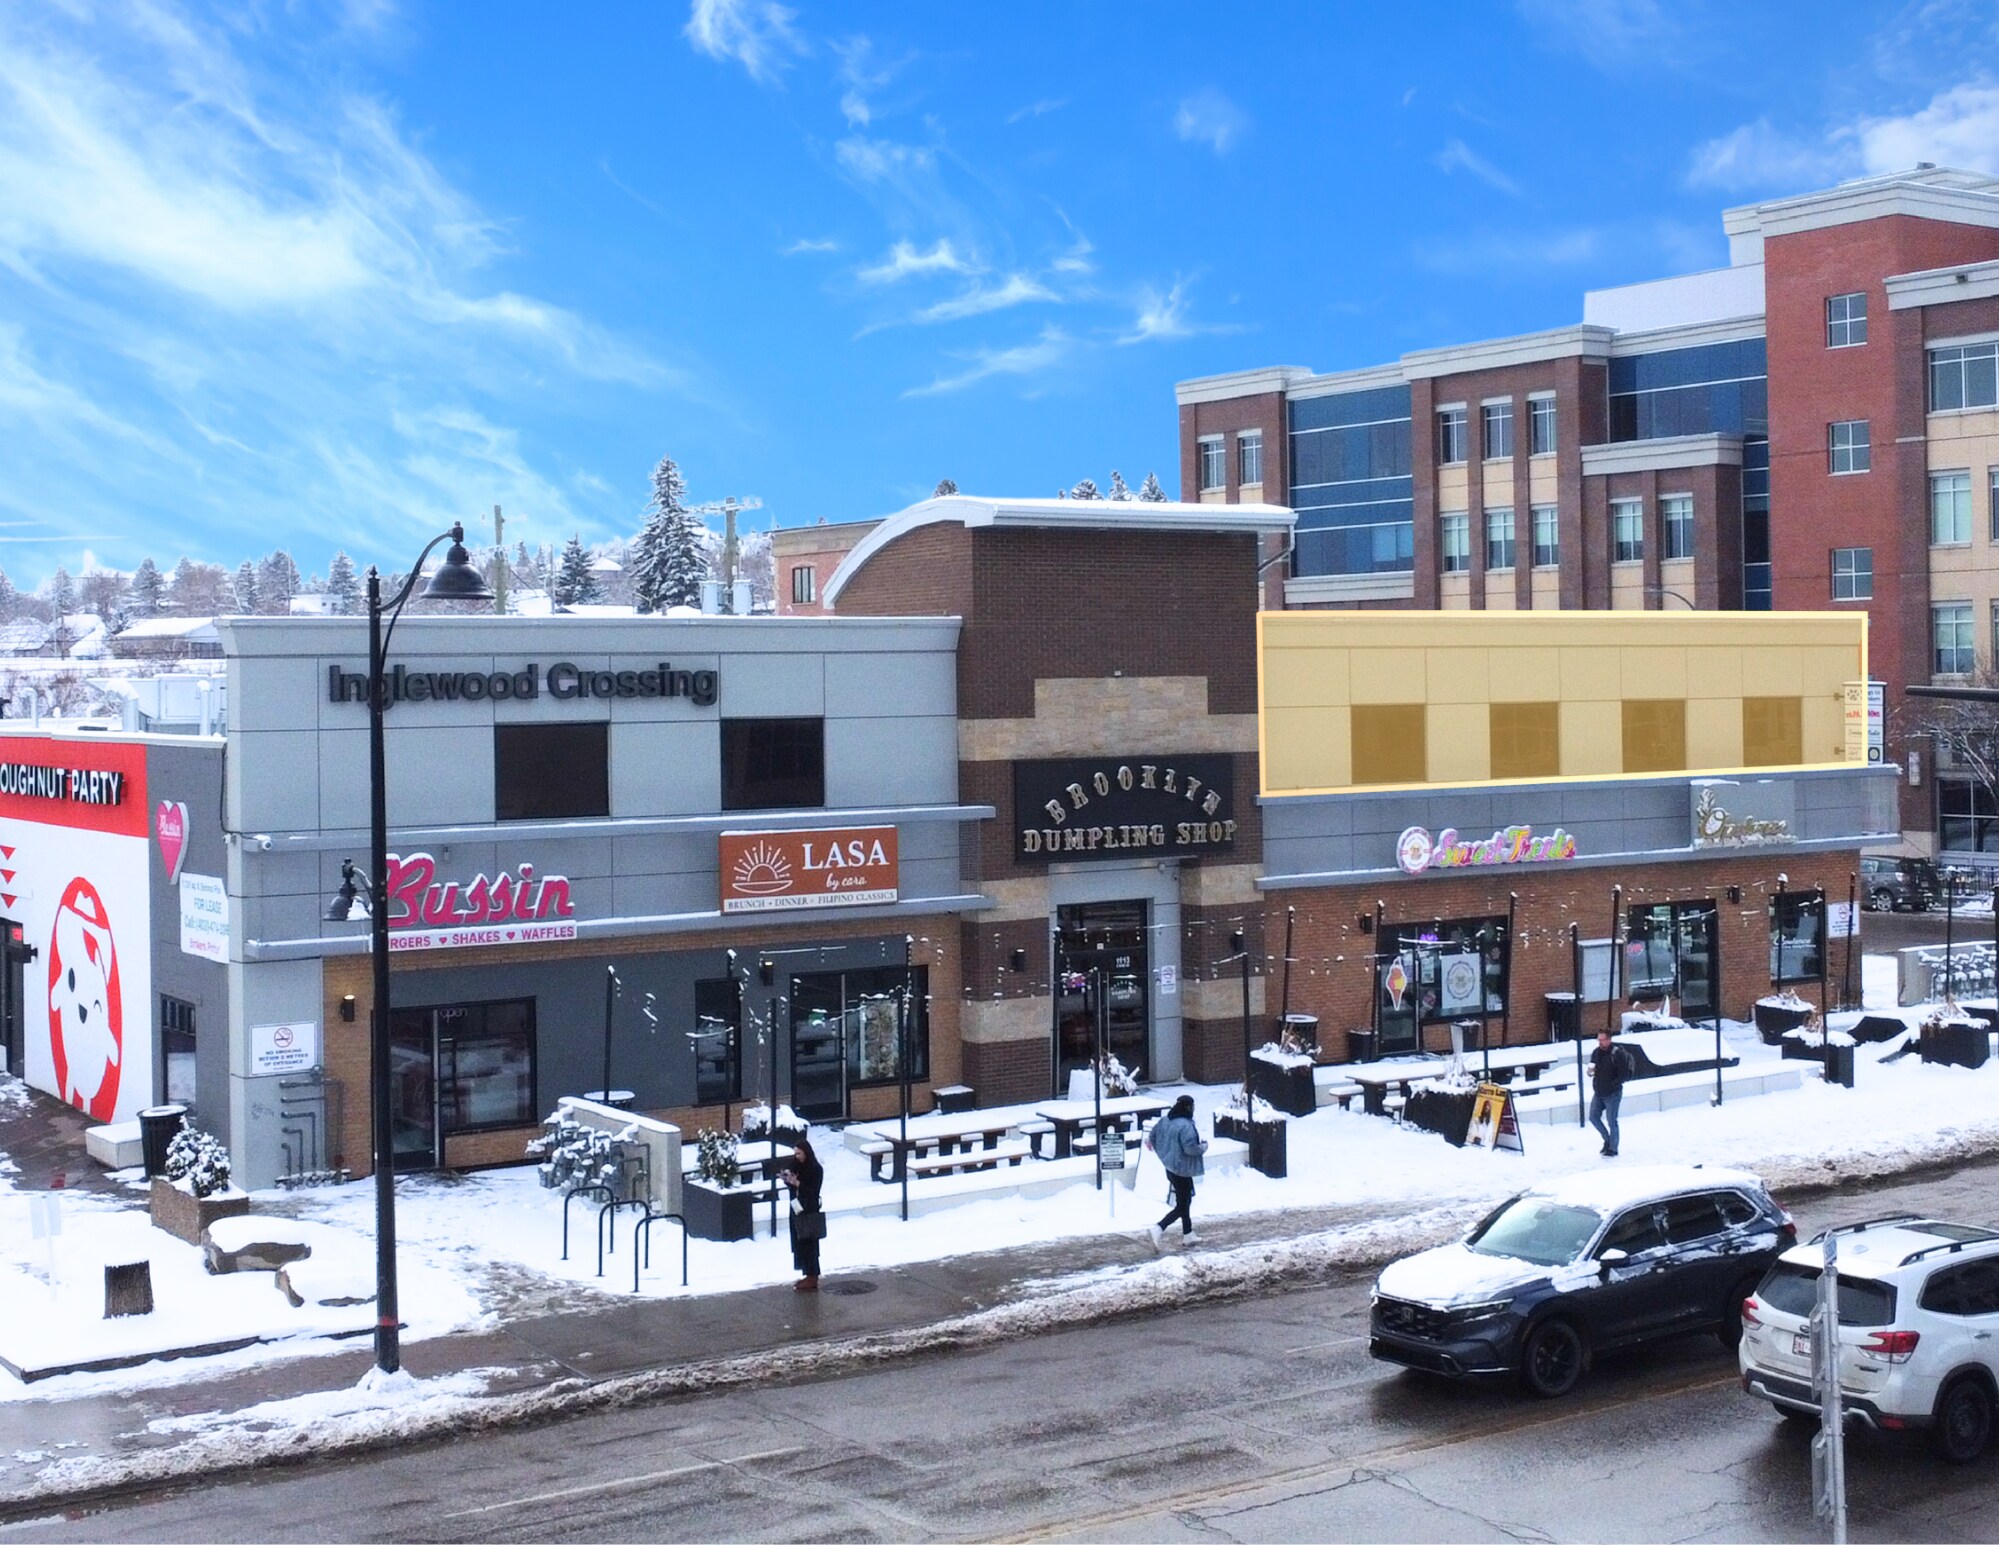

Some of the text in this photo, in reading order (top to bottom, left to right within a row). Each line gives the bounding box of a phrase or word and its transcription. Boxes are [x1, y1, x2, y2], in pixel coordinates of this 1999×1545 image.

[329, 661, 719, 711] Inglewood Crossing
[0, 762, 120, 806] OUGHNUT PARTY
[1044, 764, 1222, 825] BROOKLYN
[1023, 819, 1238, 853] DUMPLING SHOP
[1434, 828, 1505, 868] Sweet
[801, 839, 890, 871] LASA
[386, 852, 576, 928] Bussin
[826, 872, 840, 891] by
[728, 890, 895, 910] BRUNCH DINNER FILIPINO CLASSICS
[390, 925, 575, 949] RGERS SHAKES WAFFLES
[440, 1007, 468, 1023] open
